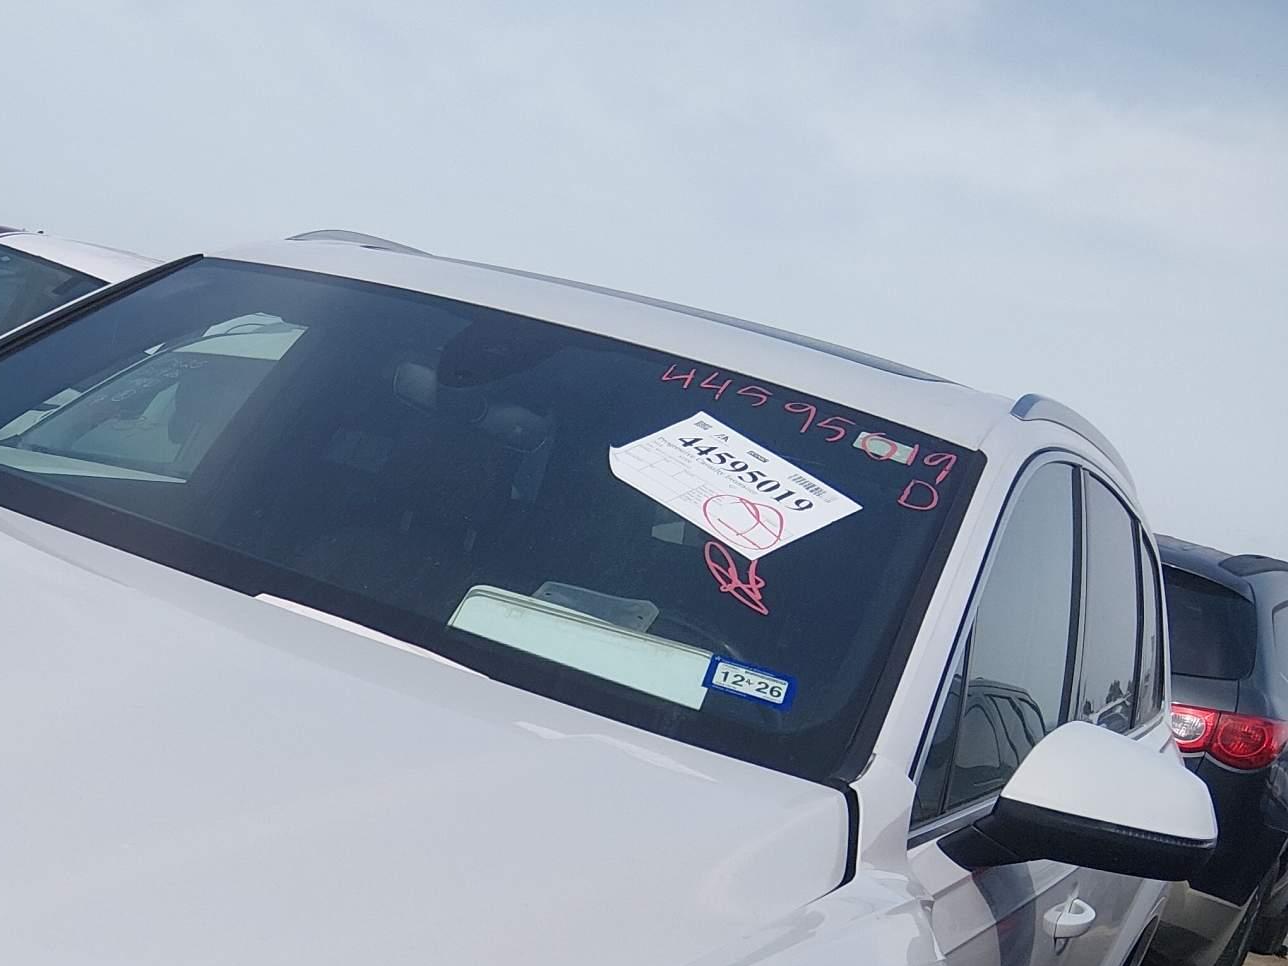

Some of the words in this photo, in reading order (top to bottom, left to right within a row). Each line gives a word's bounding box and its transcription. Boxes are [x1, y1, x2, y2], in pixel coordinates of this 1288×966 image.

[662, 364, 958, 484] 44595019
[678, 436, 815, 512] 44595019
[721, 671, 746, 687] 12
[756, 682, 783, 698] 26
